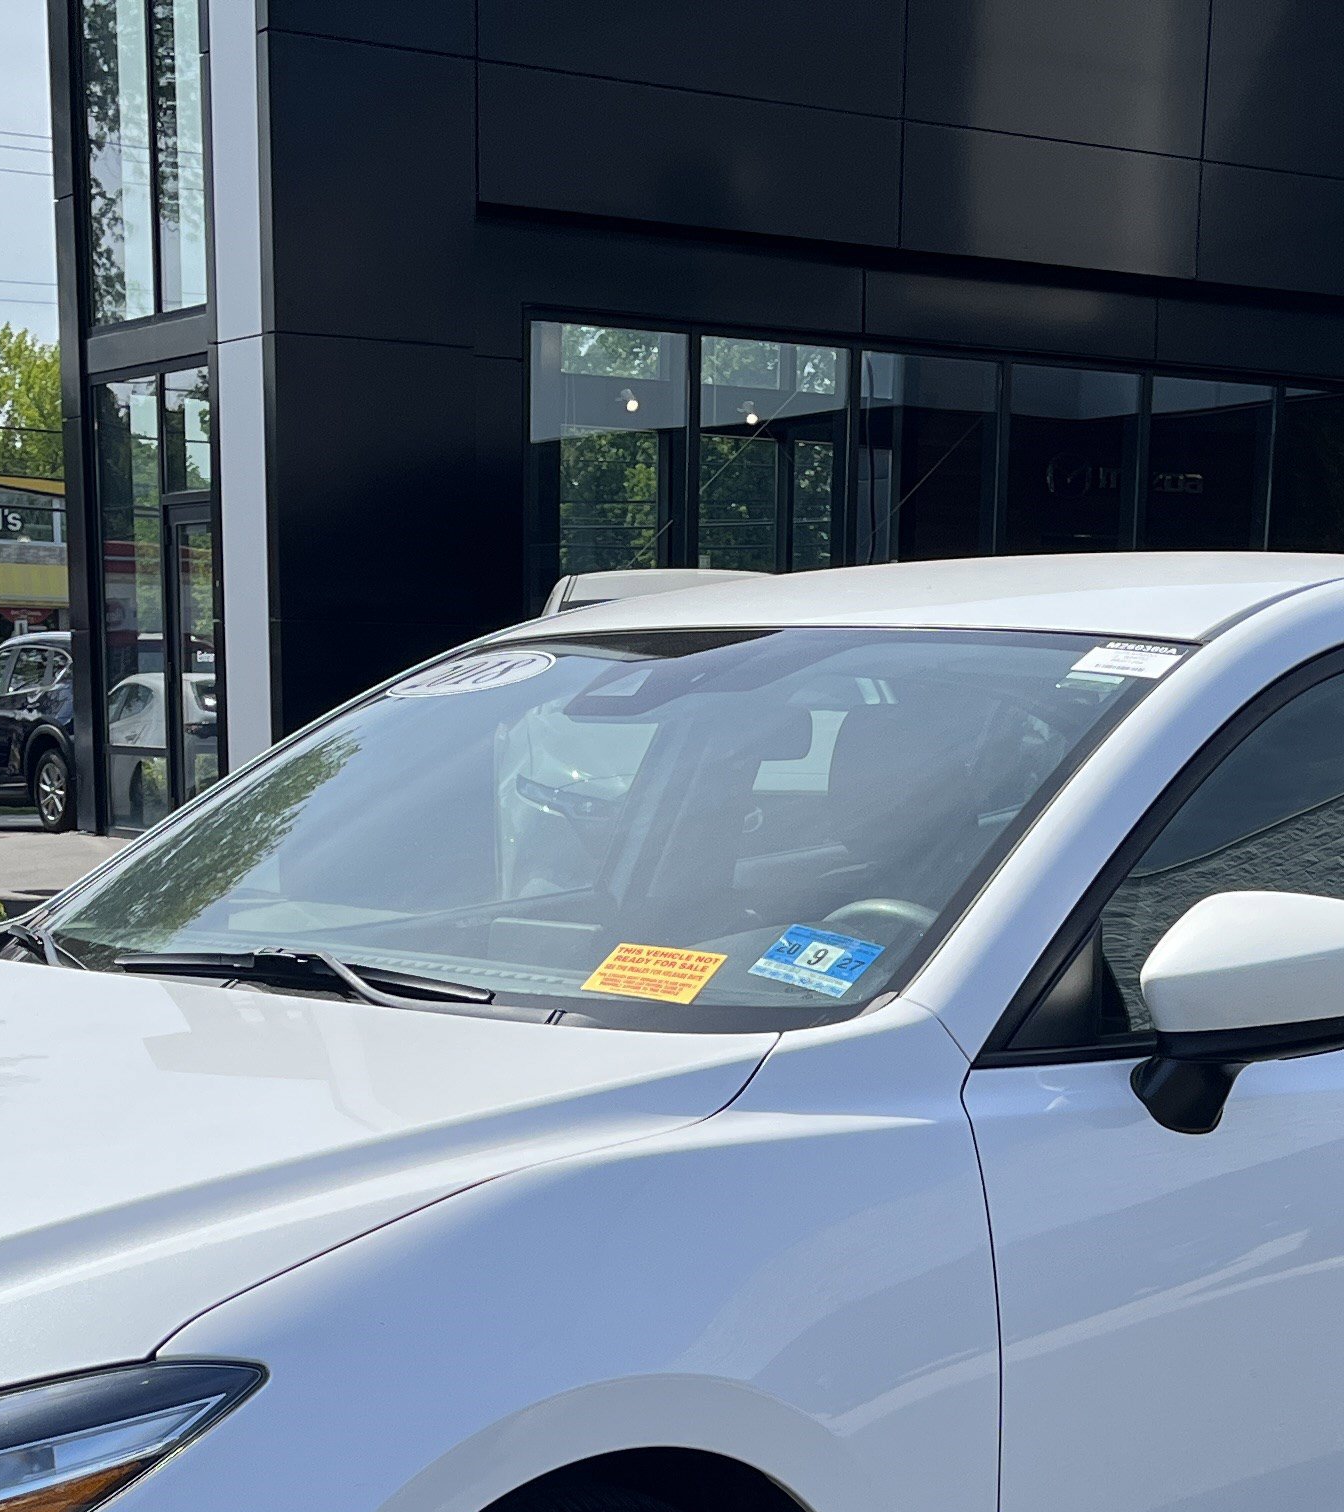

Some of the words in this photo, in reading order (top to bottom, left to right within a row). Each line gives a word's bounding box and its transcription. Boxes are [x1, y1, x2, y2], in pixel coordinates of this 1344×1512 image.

[614, 955, 650, 965] READY
[652, 960, 677, 969] FOR
[679, 963, 709, 973] SALE
[618, 946, 644, 956] THIS
[646, 949, 693, 962] VEHICLE
[695, 955, 720, 965] NOT
[807, 948, 829, 966] 9
[837, 958, 865, 971] 27
